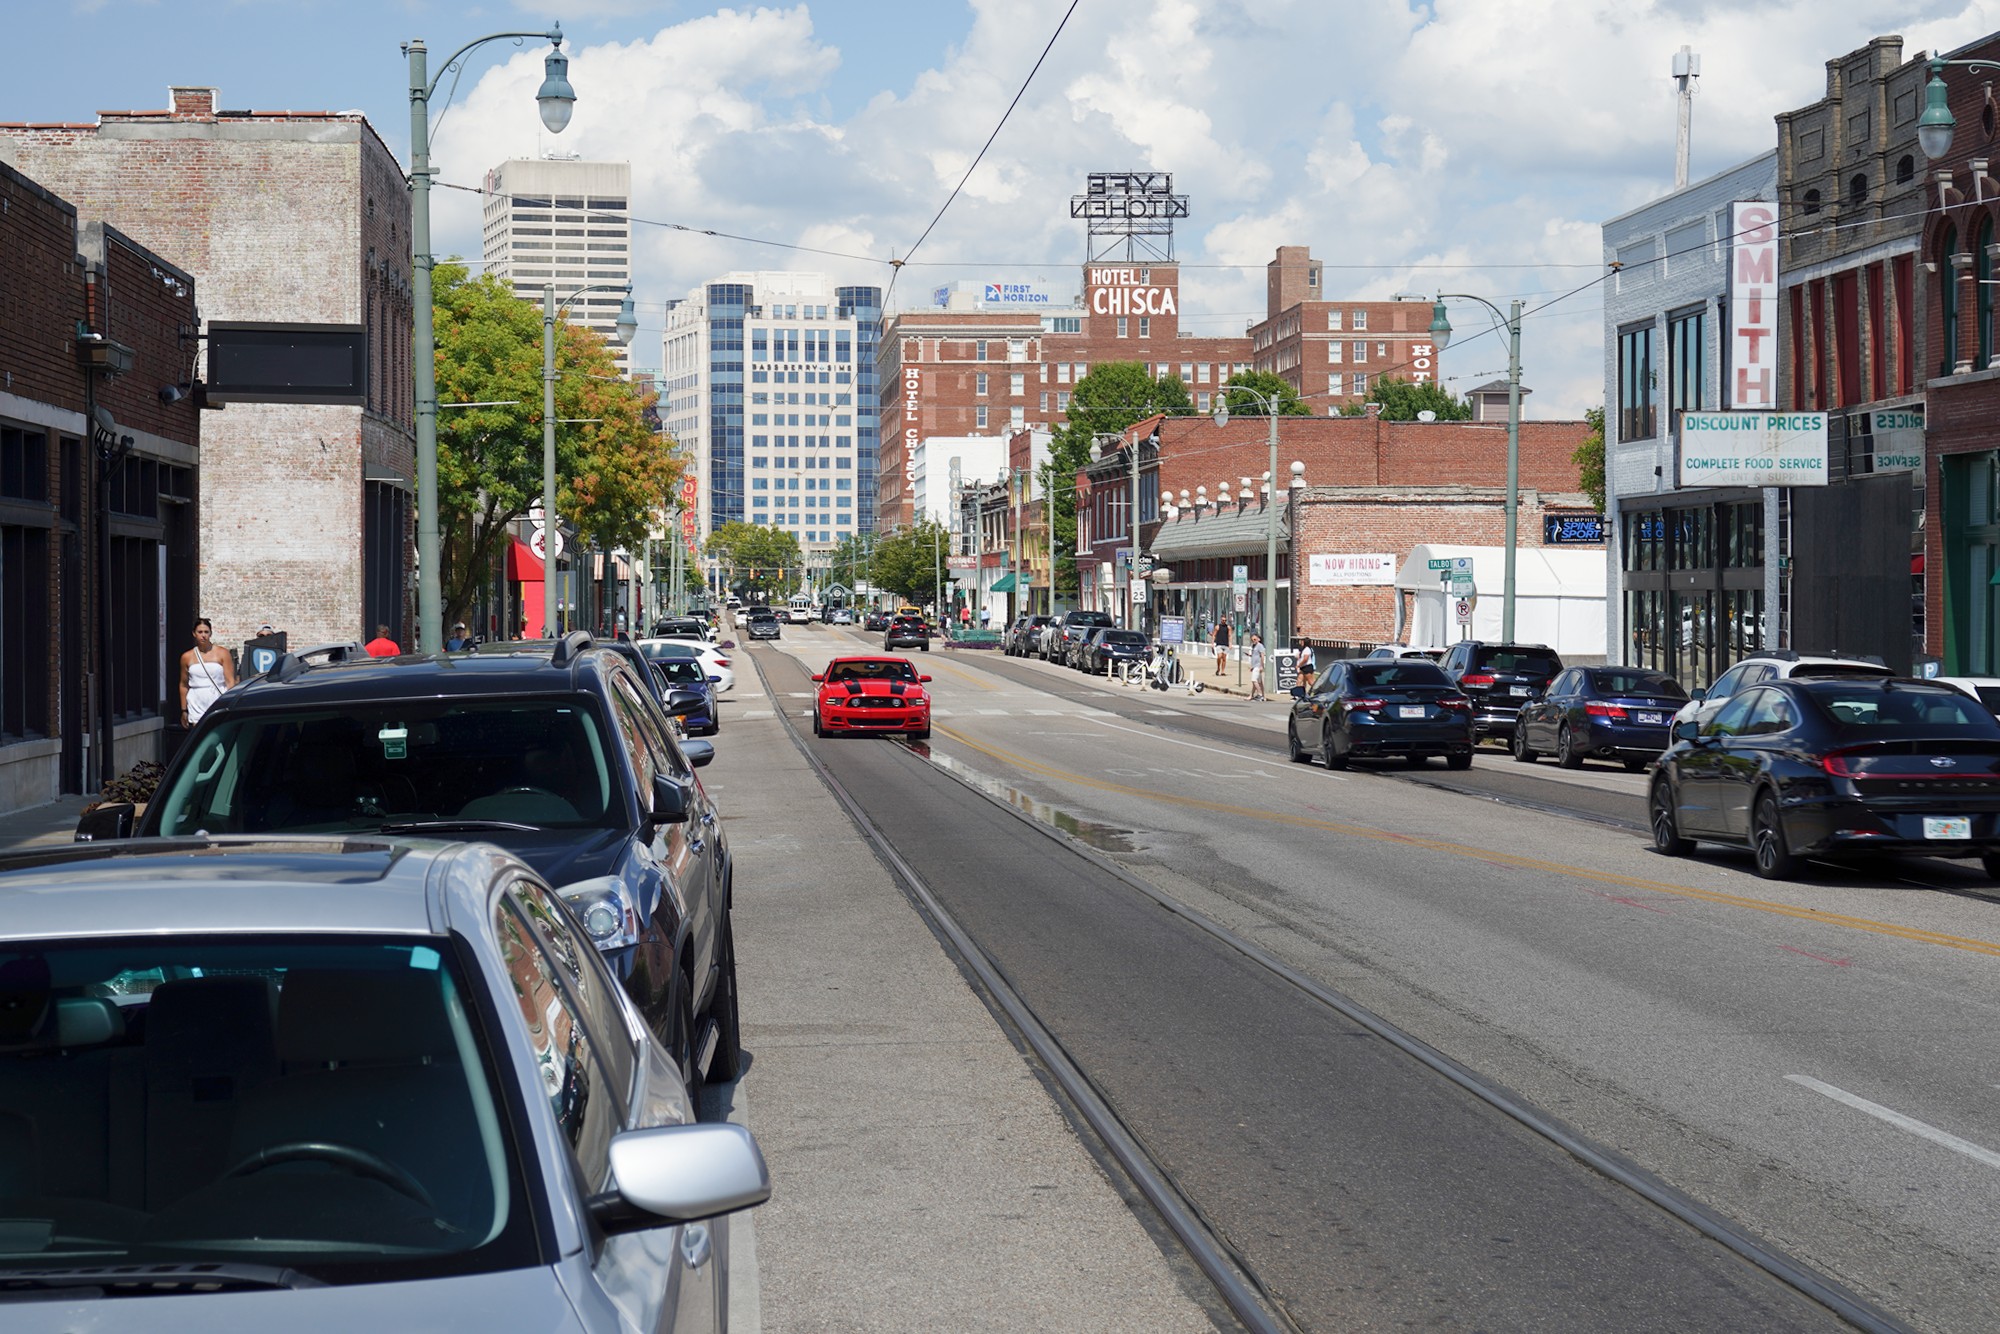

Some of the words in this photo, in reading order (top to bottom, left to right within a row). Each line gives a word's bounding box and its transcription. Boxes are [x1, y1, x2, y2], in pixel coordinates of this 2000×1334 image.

[1091, 269, 1139, 285] HOTEL
[1003, 284, 1031, 293] FIRST
[1003, 294, 1049, 302] HORIZON
[1093, 287, 1177, 315] CHISCA
[1737, 207, 1774, 404] SMITH
[1412, 345, 1432, 388] HOT
[905, 368, 920, 421] HOTEL
[1686, 416, 1760, 430] DISCOUNT
[1767, 416, 1823, 430] PRICES
[1686, 458, 1740, 469] COMPLETE
[1745, 458, 1774, 469] FOOD
[1779, 458, 1822, 469] SERVICE
[1563, 522, 1596, 530] SPINE
[1561, 530, 1601, 539] SPORT
[1325, 558, 1346, 570] NOW
[1349, 558, 1380, 570] HIRING
[1430, 560, 1451, 568] TALBO
[1133, 592, 1145, 601] 25
[259, 651, 273, 673] P
